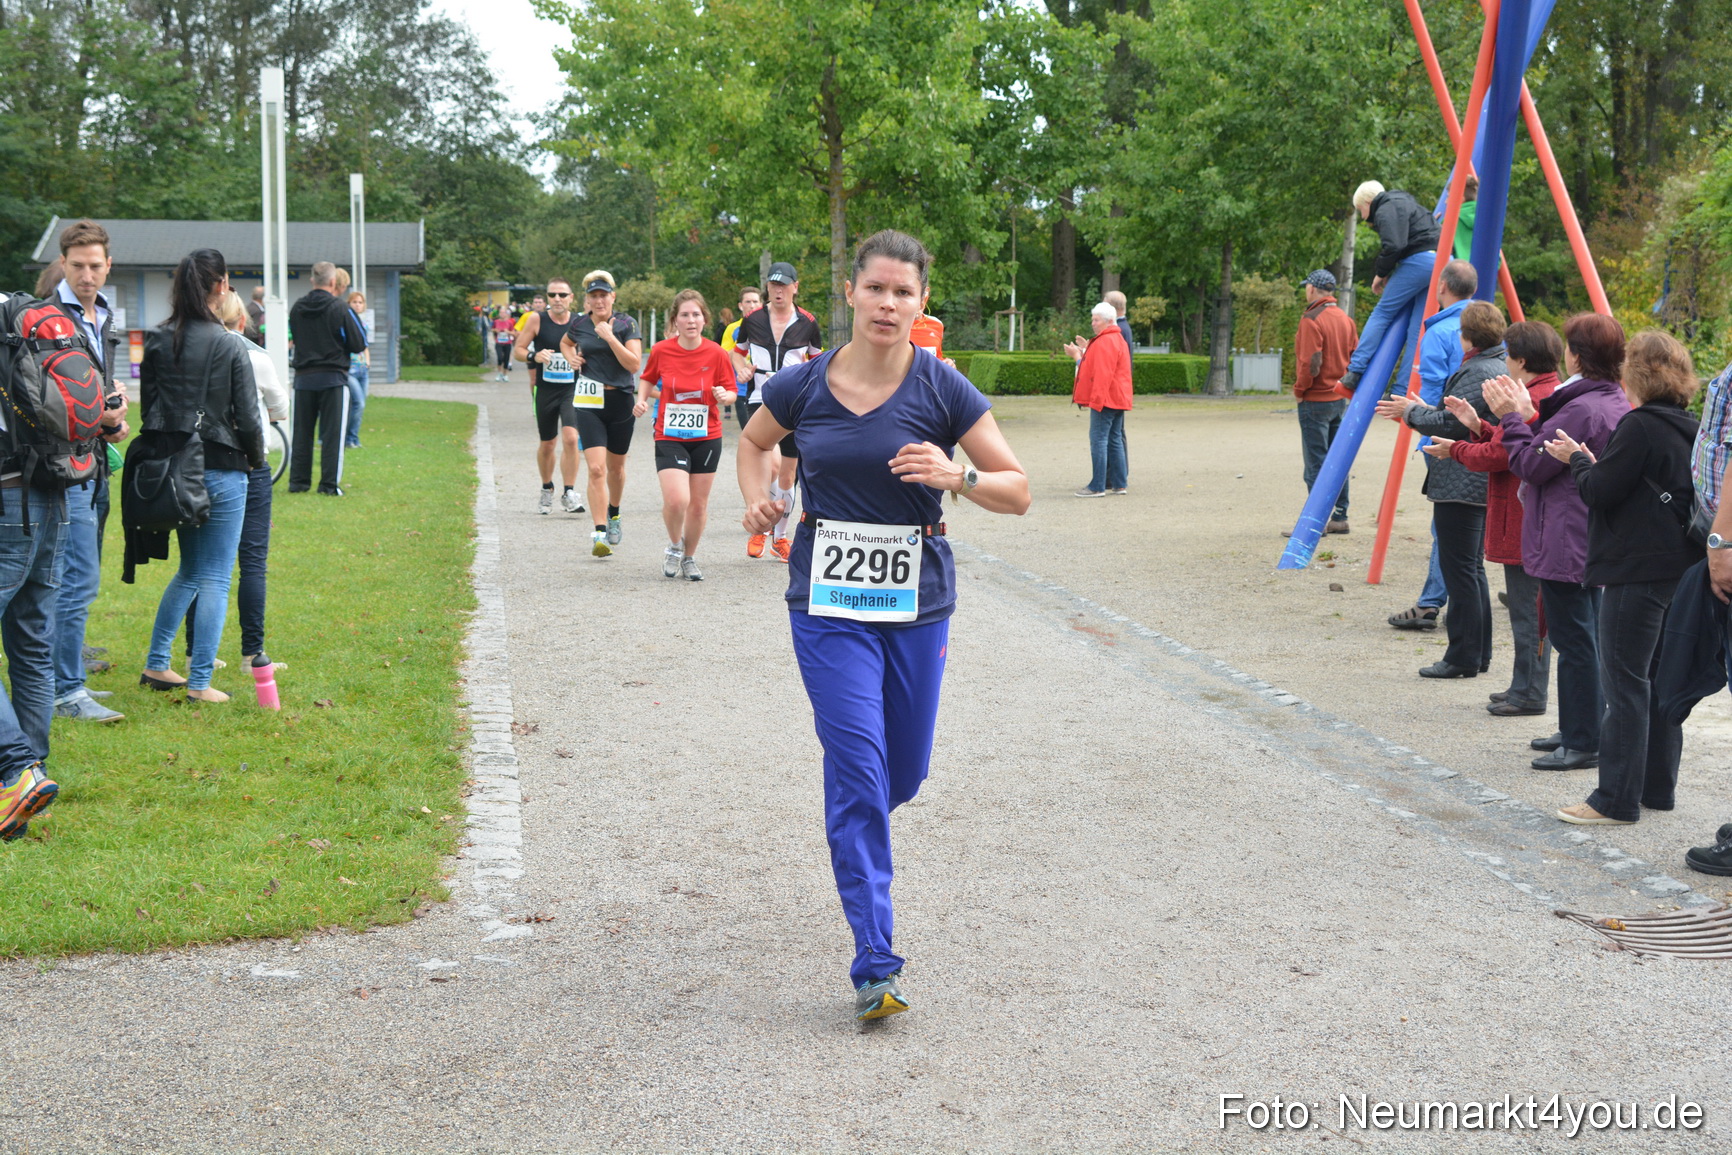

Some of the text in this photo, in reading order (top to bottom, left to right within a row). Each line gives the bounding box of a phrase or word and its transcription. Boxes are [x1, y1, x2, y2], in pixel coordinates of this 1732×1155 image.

[669, 413, 704, 428] 2230
[818, 530, 903, 544] PARTL Neumarkt
[823, 545, 911, 584] 2296
[830, 590, 897, 609] Stephanie
